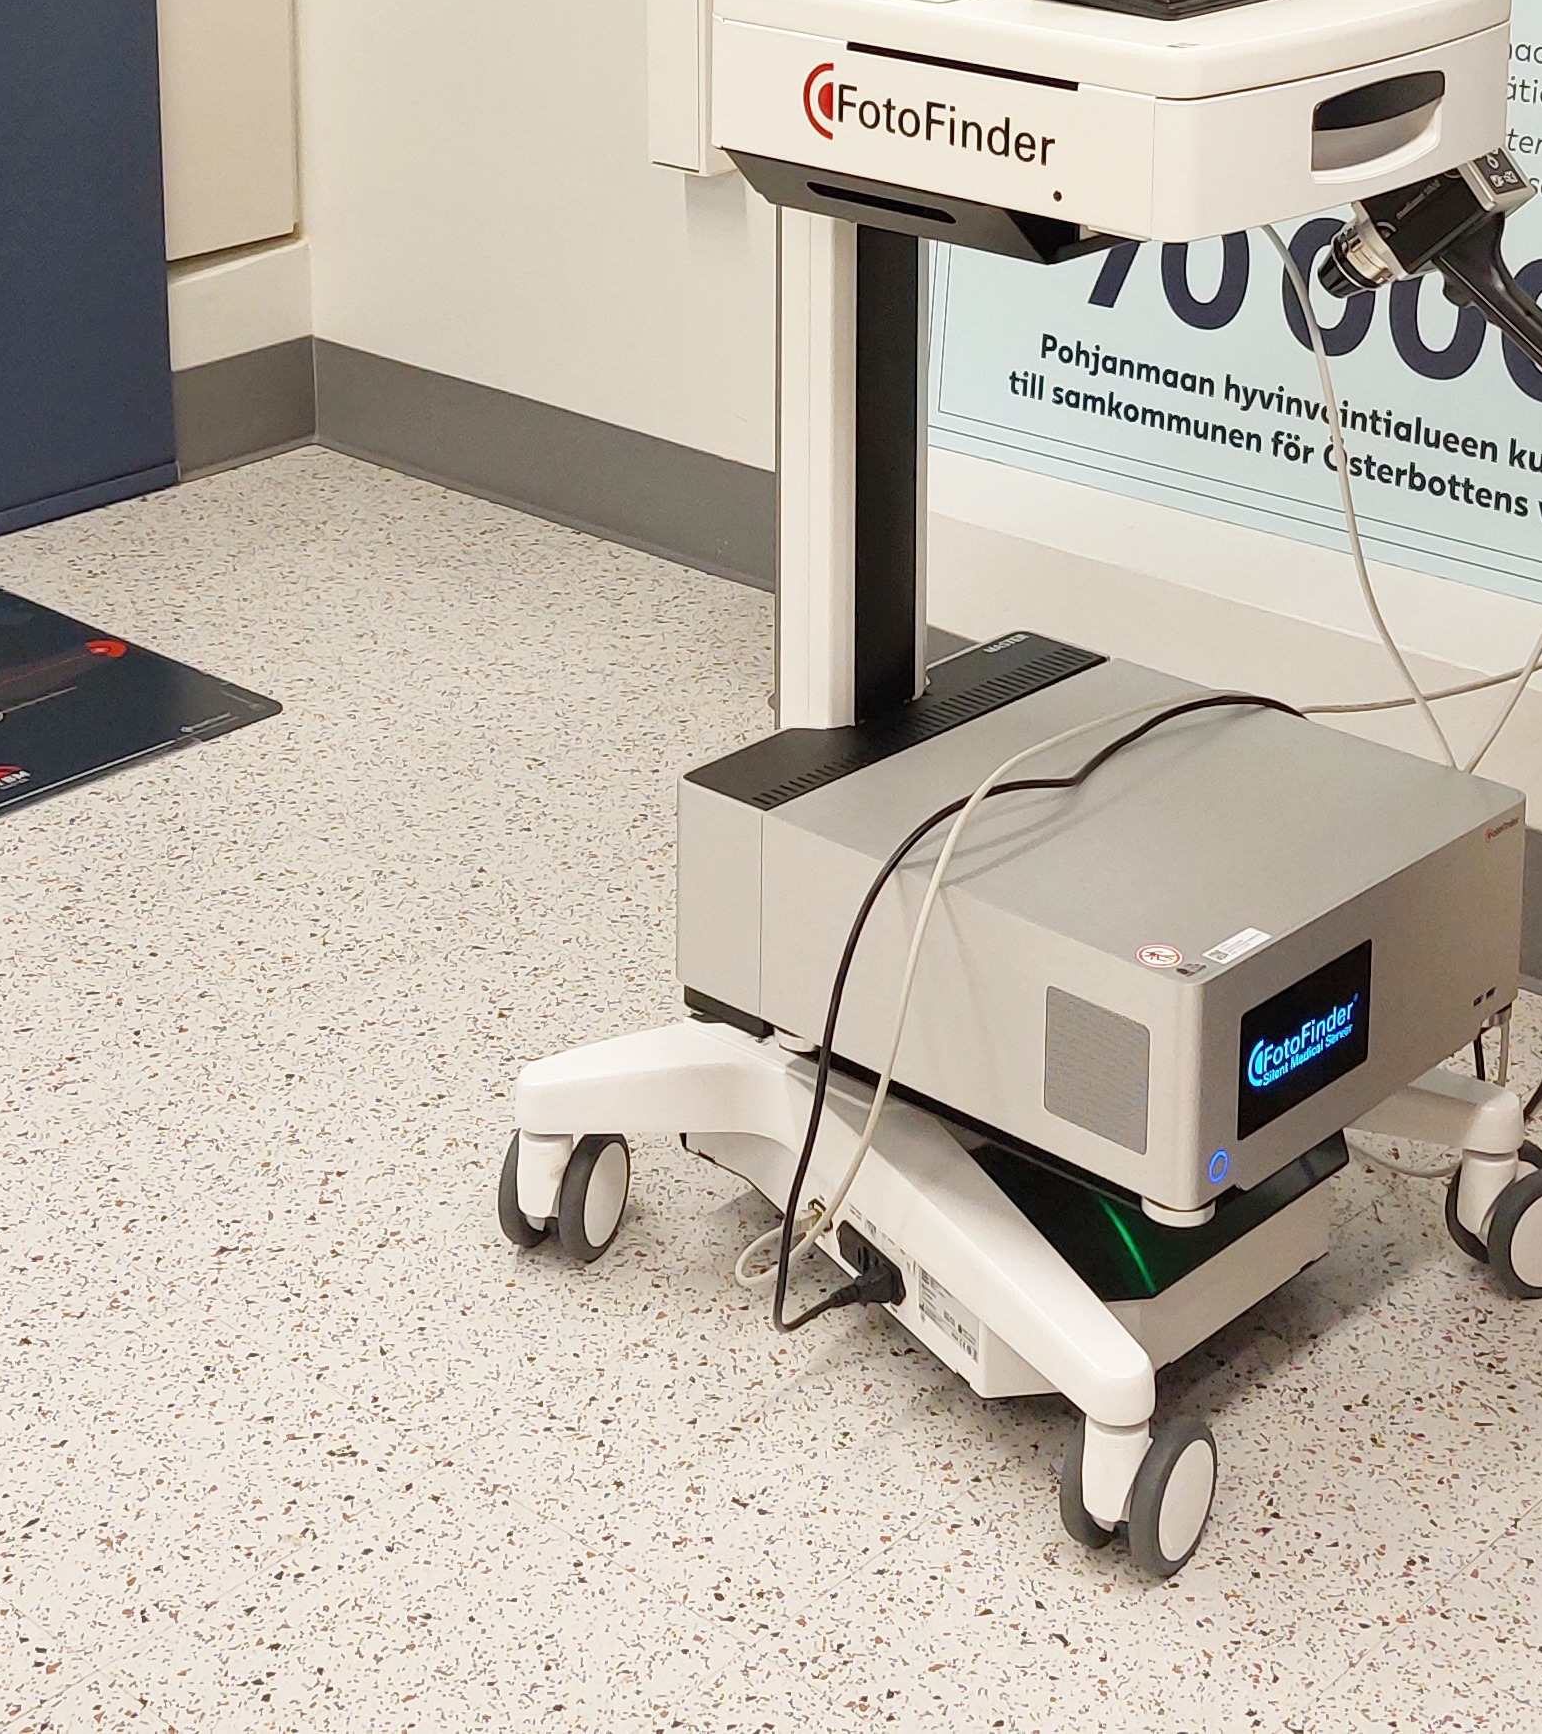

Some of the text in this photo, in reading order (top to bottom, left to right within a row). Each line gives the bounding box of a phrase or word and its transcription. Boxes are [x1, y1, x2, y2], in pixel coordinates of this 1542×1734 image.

[837, 83, 1056, 166] FotoFinder
[1040, 332, 1215, 397] Pohjanmaan
[1009, 370, 1045, 401] till
[1051, 392, 1262, 454] samkommunen
[1270, 430, 1315, 465] för
[1263, 1001, 1354, 1073] FotoFinder
[1290, 1038, 1324, 1070] Medical
